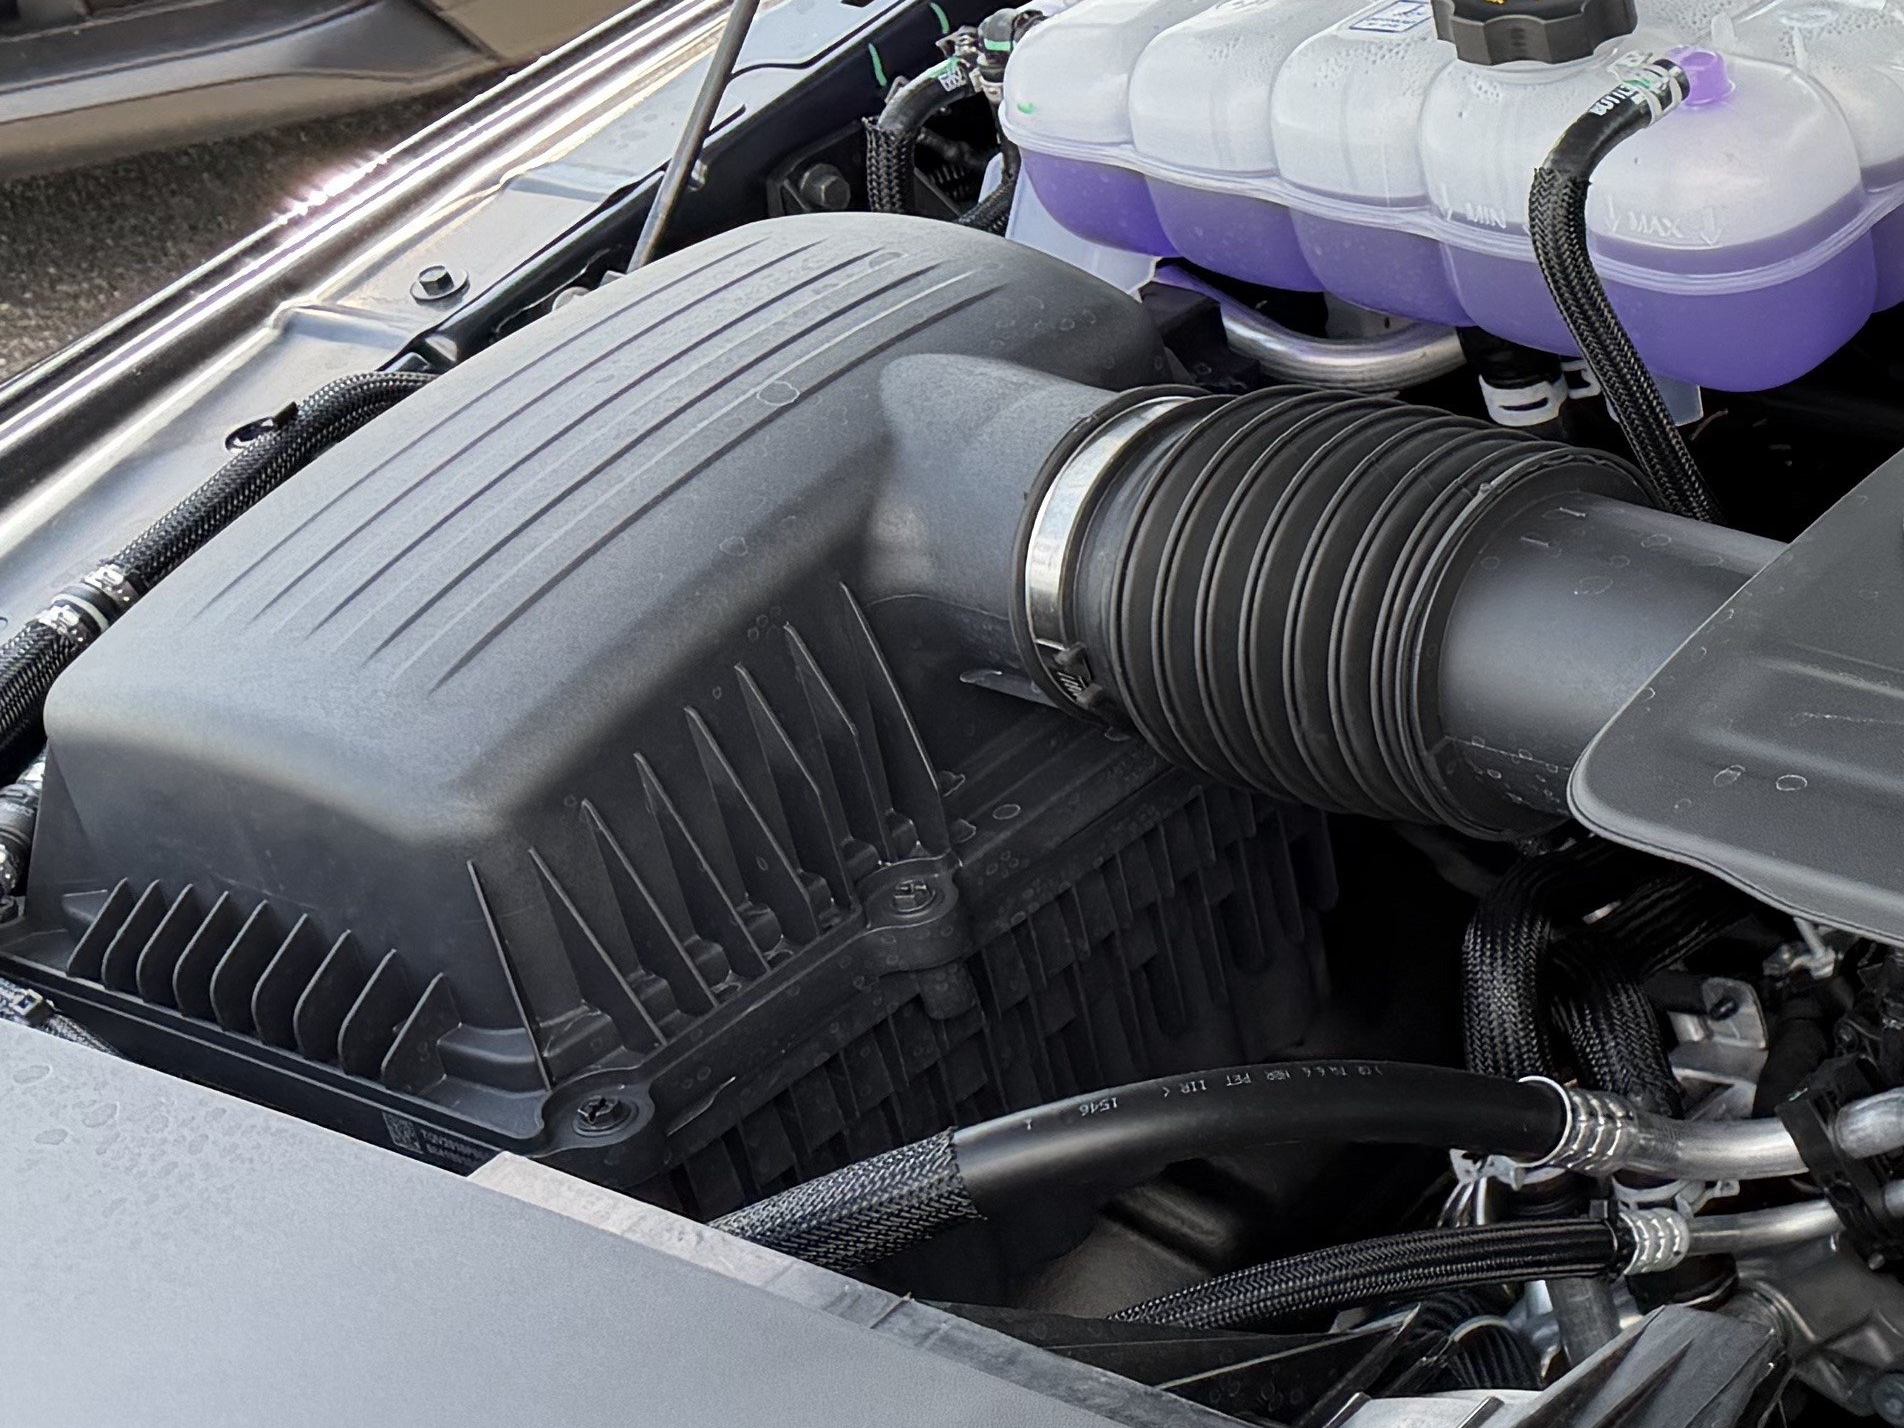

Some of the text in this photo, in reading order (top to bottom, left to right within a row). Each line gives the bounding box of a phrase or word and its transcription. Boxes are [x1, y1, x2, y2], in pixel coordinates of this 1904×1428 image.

[1466, 203, 1685, 240] MIN MAX
[1078, 1095, 1119, 1117] 1546
